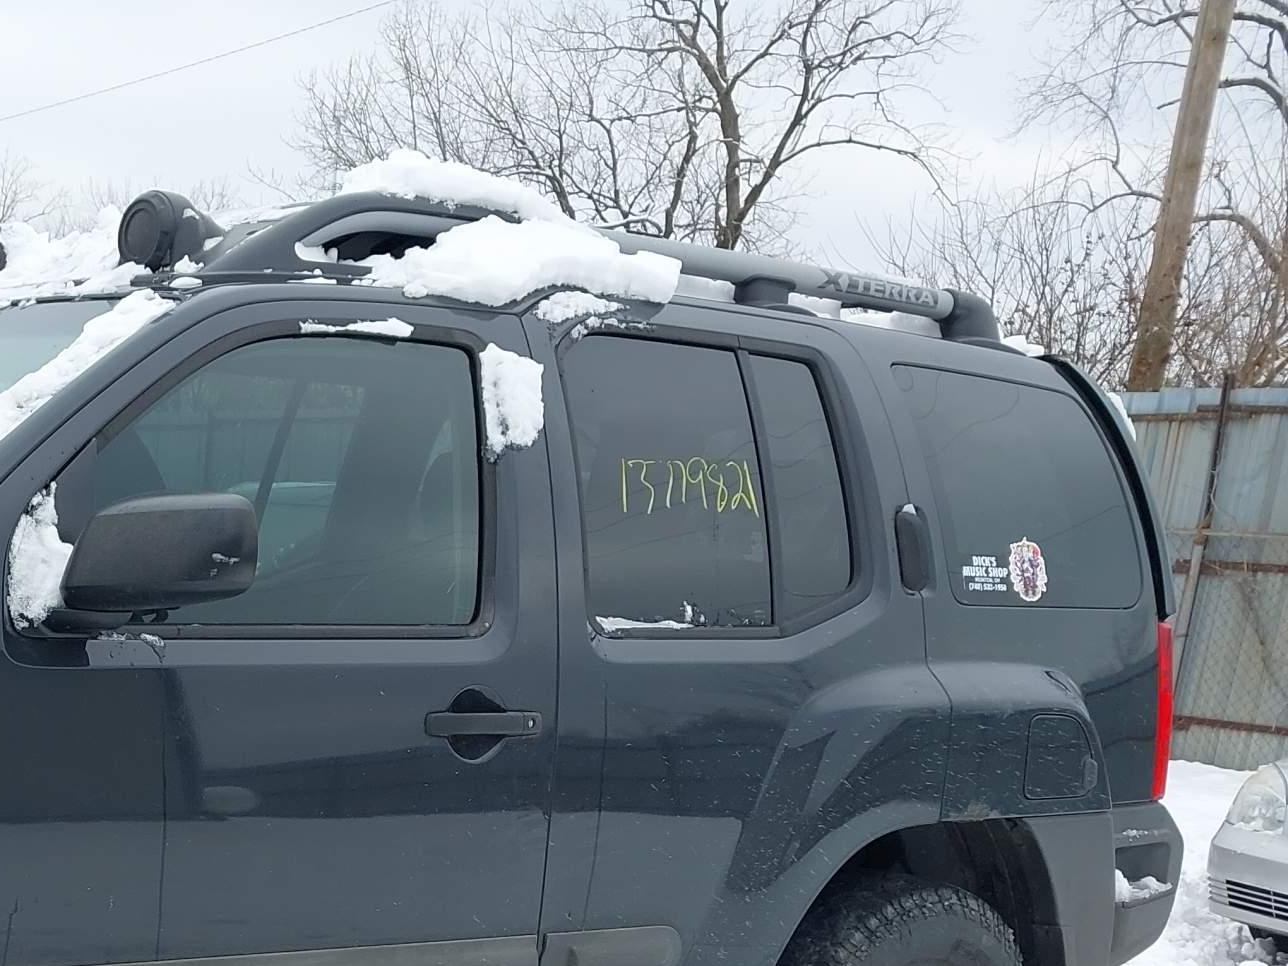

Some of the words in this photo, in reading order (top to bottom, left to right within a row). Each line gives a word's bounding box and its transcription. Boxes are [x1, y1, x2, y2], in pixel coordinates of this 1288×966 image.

[817, 268, 939, 308] XTERRA
[962, 566, 987, 577] MUSIC
[988, 567, 1009, 578] SHOP
